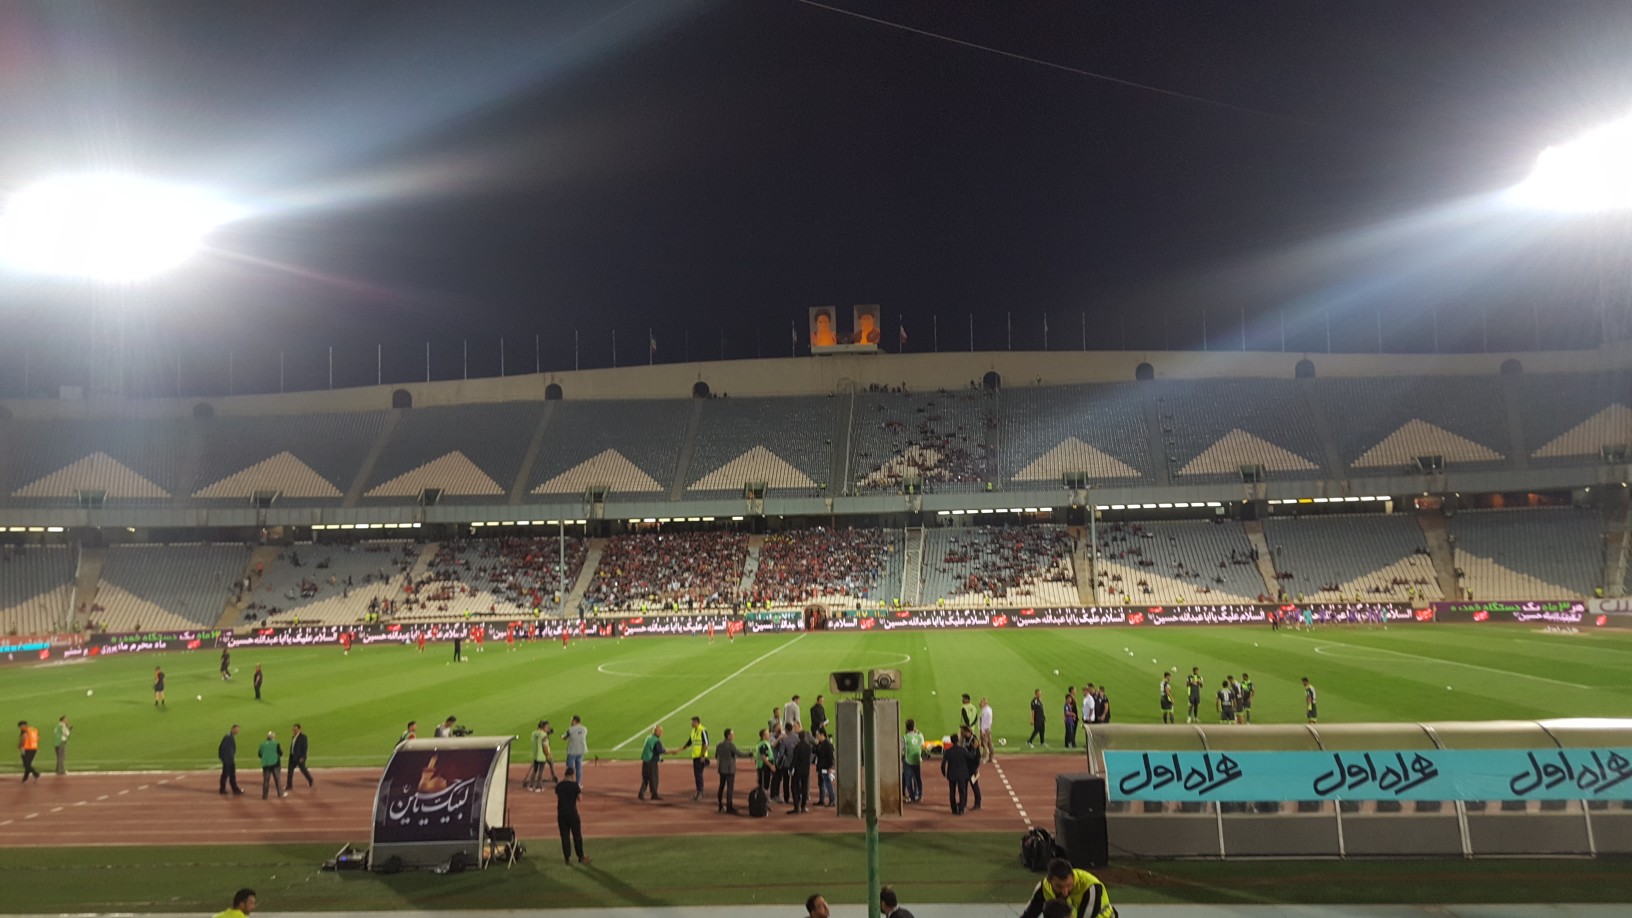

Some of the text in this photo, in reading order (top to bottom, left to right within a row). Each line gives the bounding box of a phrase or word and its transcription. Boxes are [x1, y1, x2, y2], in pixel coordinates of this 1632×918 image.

[1119, 752, 1183, 795] اول
[1313, 752, 1378, 796] اول
[1509, 751, 1575, 796] اول
